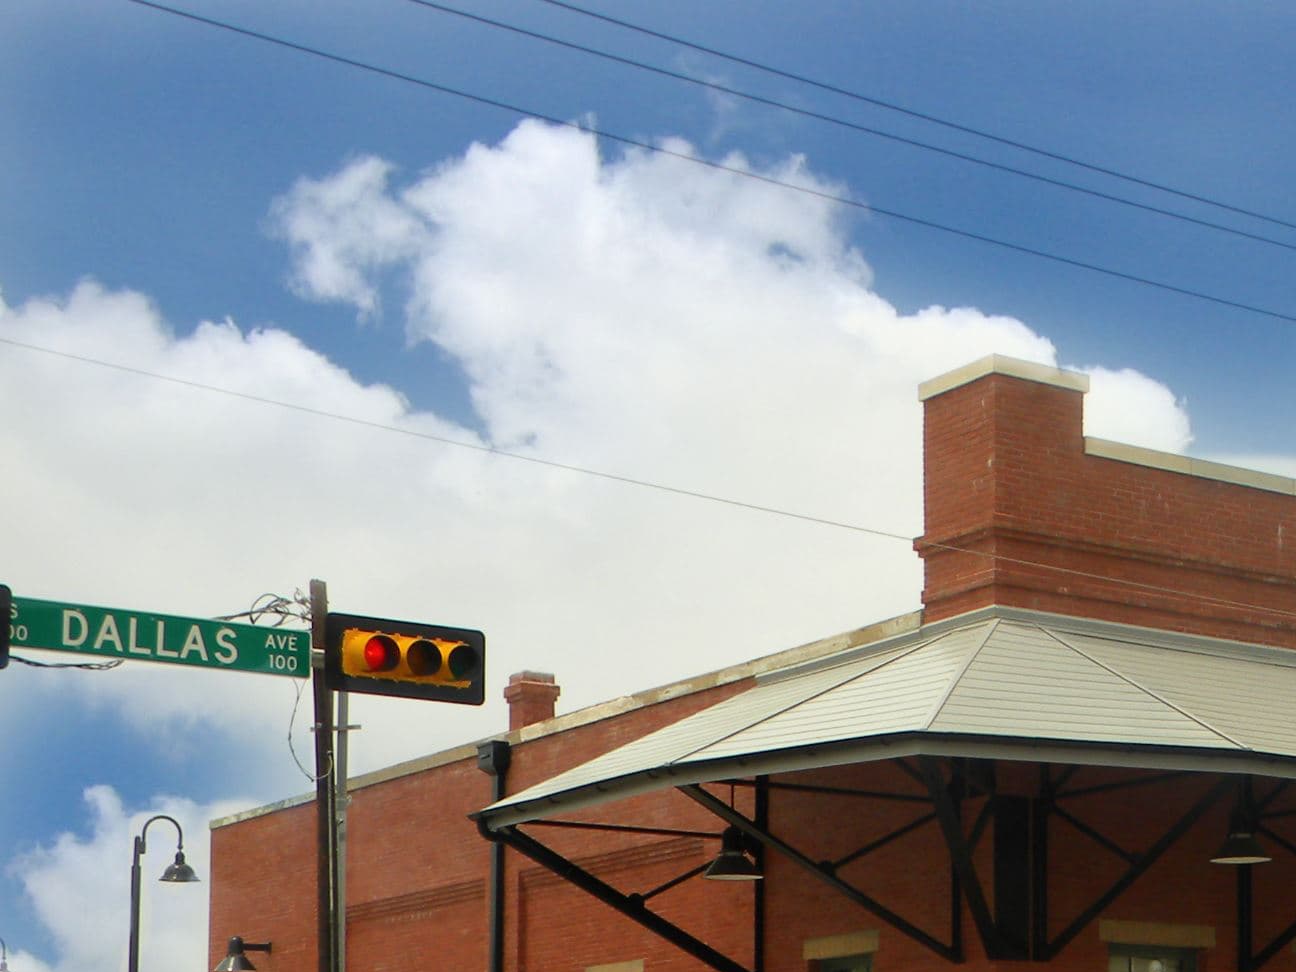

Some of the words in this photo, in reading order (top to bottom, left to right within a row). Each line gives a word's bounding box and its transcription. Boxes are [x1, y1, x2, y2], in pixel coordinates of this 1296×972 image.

[62, 609, 239, 664] DALLAS
[264, 634, 298, 651] AVE
[269, 654, 298, 671] 100
